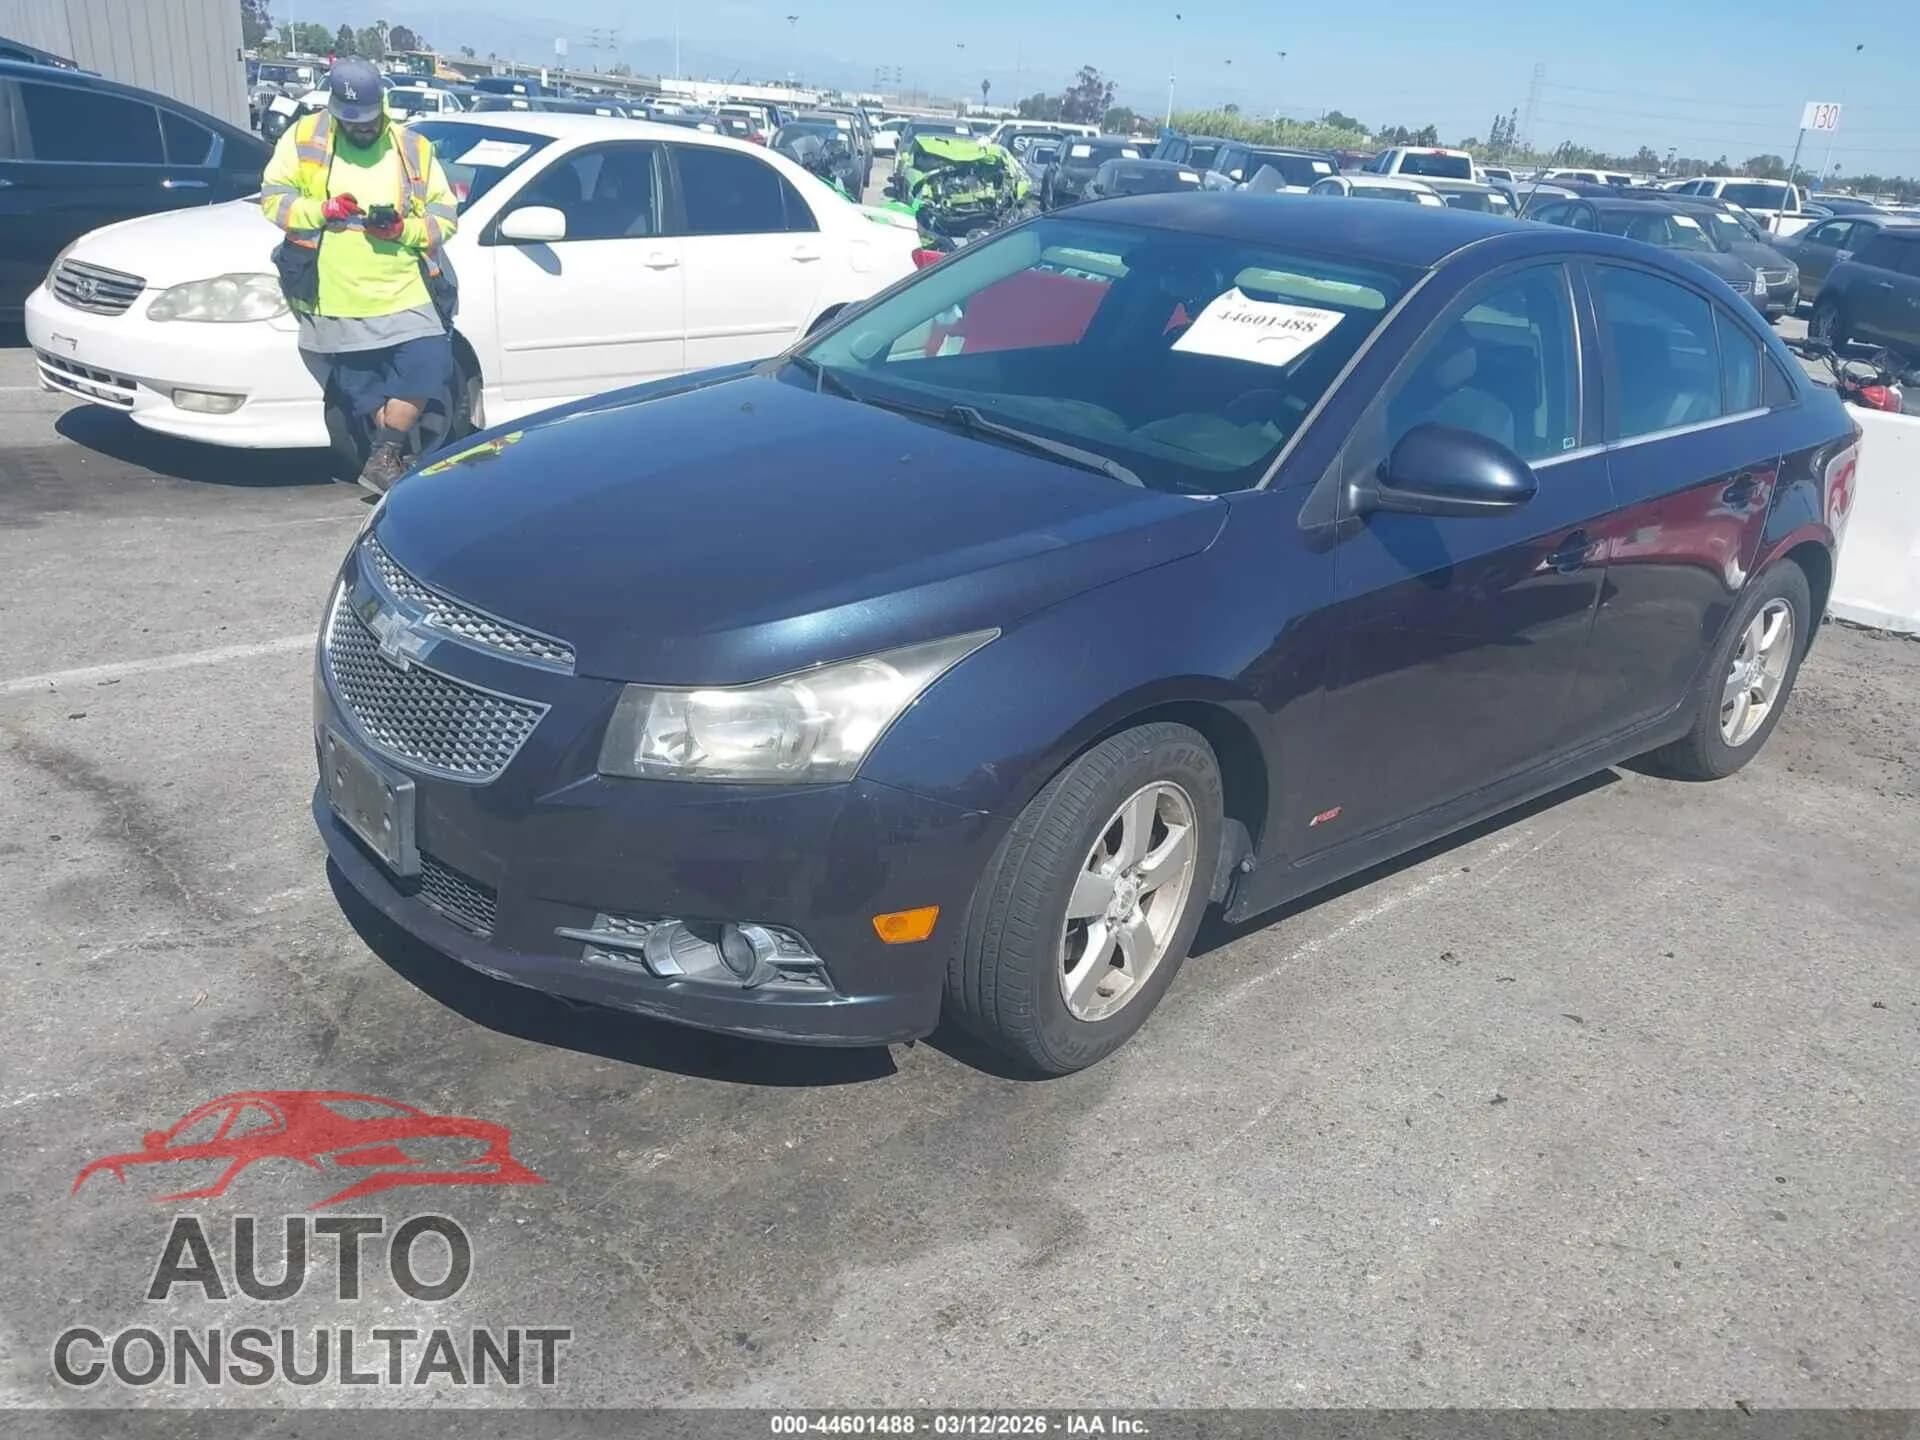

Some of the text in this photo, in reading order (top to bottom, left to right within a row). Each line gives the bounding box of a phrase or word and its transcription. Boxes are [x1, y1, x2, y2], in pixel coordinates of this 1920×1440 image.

[344, 80, 359, 100] LA
[1812, 104, 1838, 129] 130
[1217, 311, 1318, 333] 44601488
